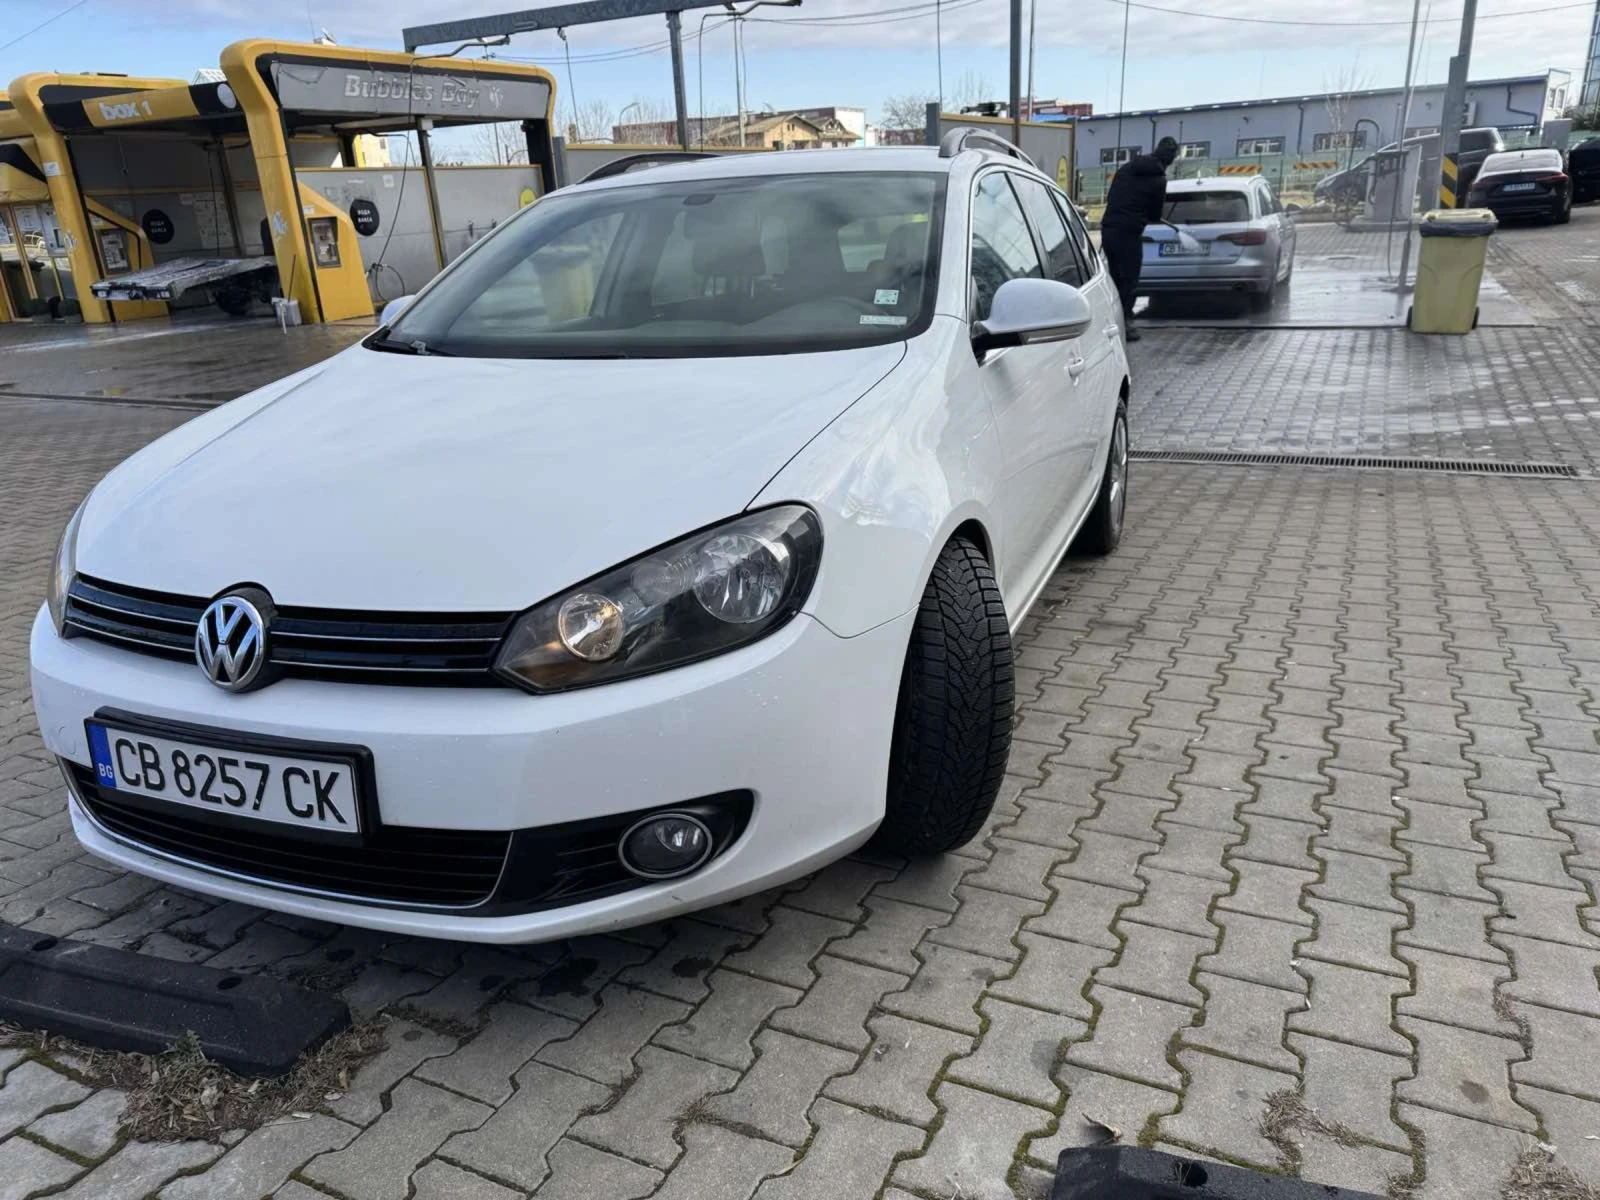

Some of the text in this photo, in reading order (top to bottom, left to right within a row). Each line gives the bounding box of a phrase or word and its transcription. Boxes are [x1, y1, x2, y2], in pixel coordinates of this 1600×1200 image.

[98, 100, 153, 120] box 1
[98, 762, 114, 779] BG
[115, 737, 348, 824] CB 8257 CK
